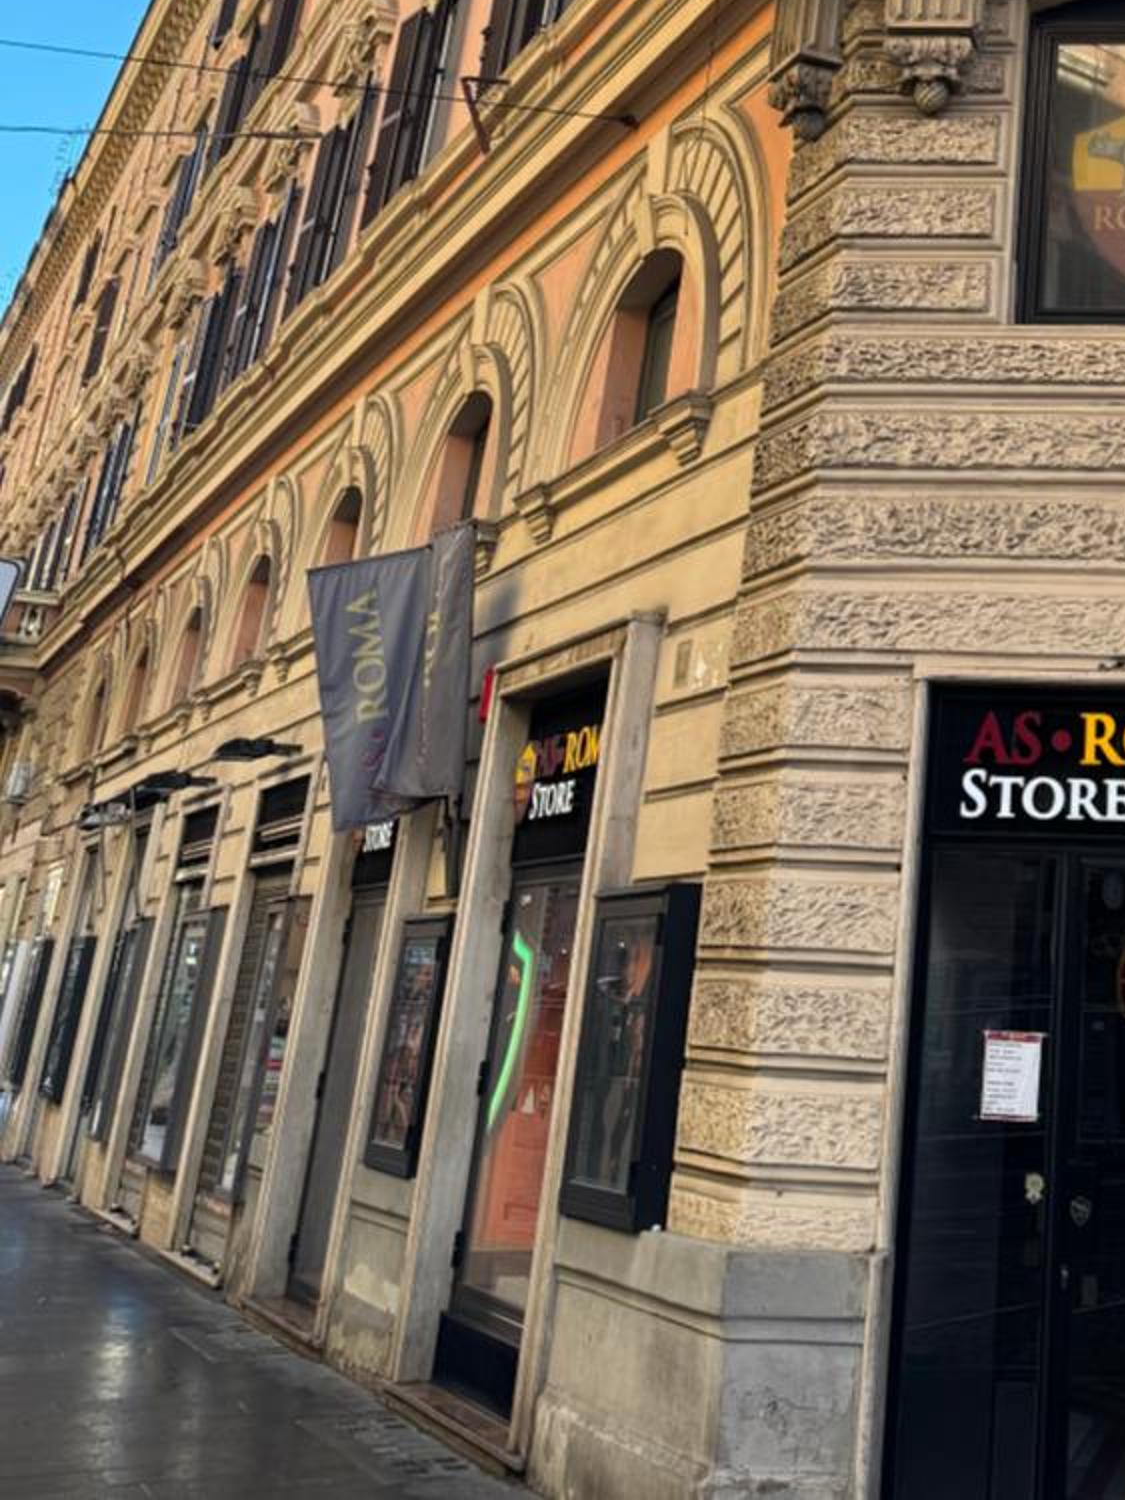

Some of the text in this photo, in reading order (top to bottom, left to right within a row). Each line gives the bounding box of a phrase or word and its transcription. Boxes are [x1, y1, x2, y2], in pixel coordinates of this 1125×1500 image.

[346, 587, 390, 724] ROMA
[562, 725, 600, 774] ROM
[963, 710, 1044, 765] AS
[528, 779, 576, 820] STORE
